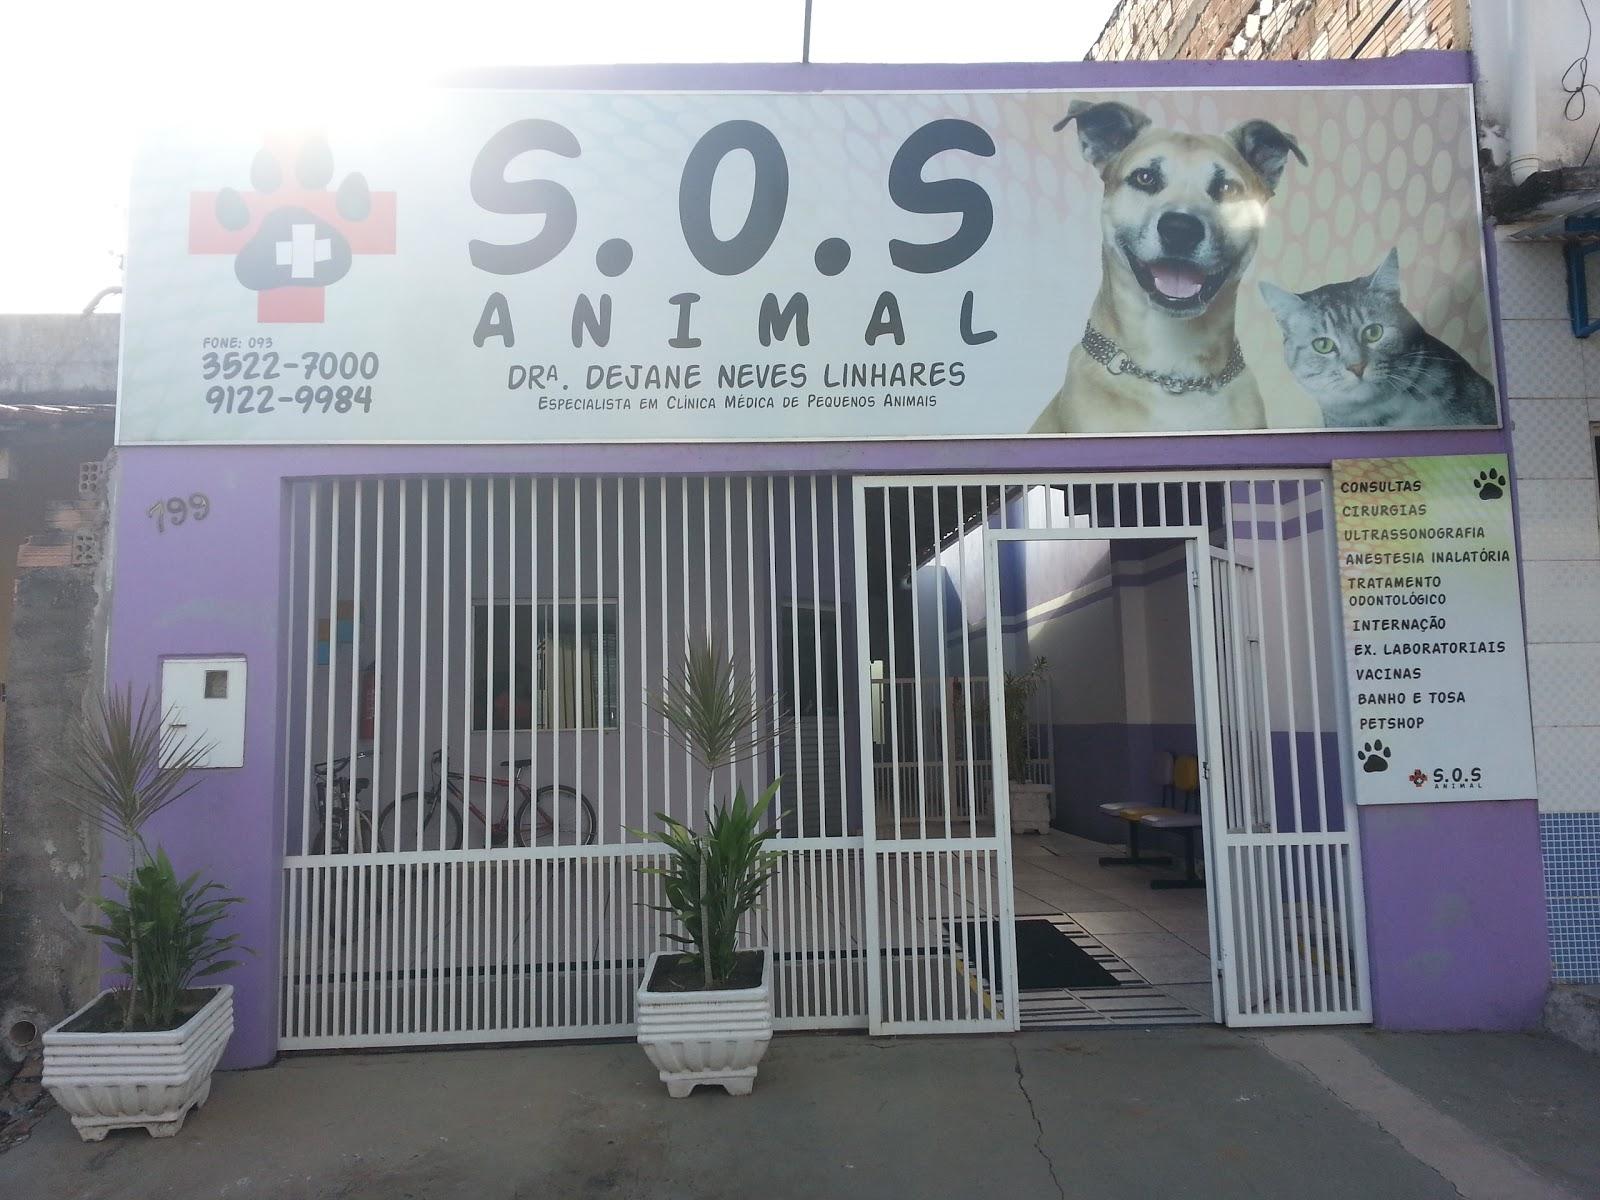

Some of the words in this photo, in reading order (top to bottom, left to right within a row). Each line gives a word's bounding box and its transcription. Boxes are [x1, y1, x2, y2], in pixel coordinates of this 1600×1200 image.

[468, 118, 996, 277] S.O.S
[472, 290, 998, 349] ANIMAL
[203, 337, 241, 348] FONE:
[248, 337, 273, 348] 093
[202, 351, 379, 380] 3522-7000
[586, 364, 702, 391] DEJANE
[718, 363, 807, 389] NEVES
[824, 361, 966, 388] LINHARES
[205, 385, 373, 414] 9122-9984
[1341, 480, 1422, 493] CONSULTAS
[1342, 504, 1427, 517] CIRURGIAS
[1344, 527, 1485, 541] ULTRASSONOGRAFIA
[1346, 552, 1425, 565] ANESTESIA
[1431, 548, 1510, 562] INALATÓRIA
[1348, 576, 1441, 589] TRATAMENTO
[1349, 591, 1447, 606] ODONTOLÓGICO
[1353, 615, 1446, 633] INTERNAÇÃO
[1354, 644, 1377, 656] EX.
[1384, 642, 1506, 655] LABORATORIAIS
[1356, 668, 1422, 680] VACINAS
[1358, 693, 1406, 705] BANHO
[1413, 693, 1422, 704] E
[1429, 692, 1466, 703] TOSA
[1360, 717, 1425, 730] PETSHOP
[1433, 767, 1482, 783] S.O.S
